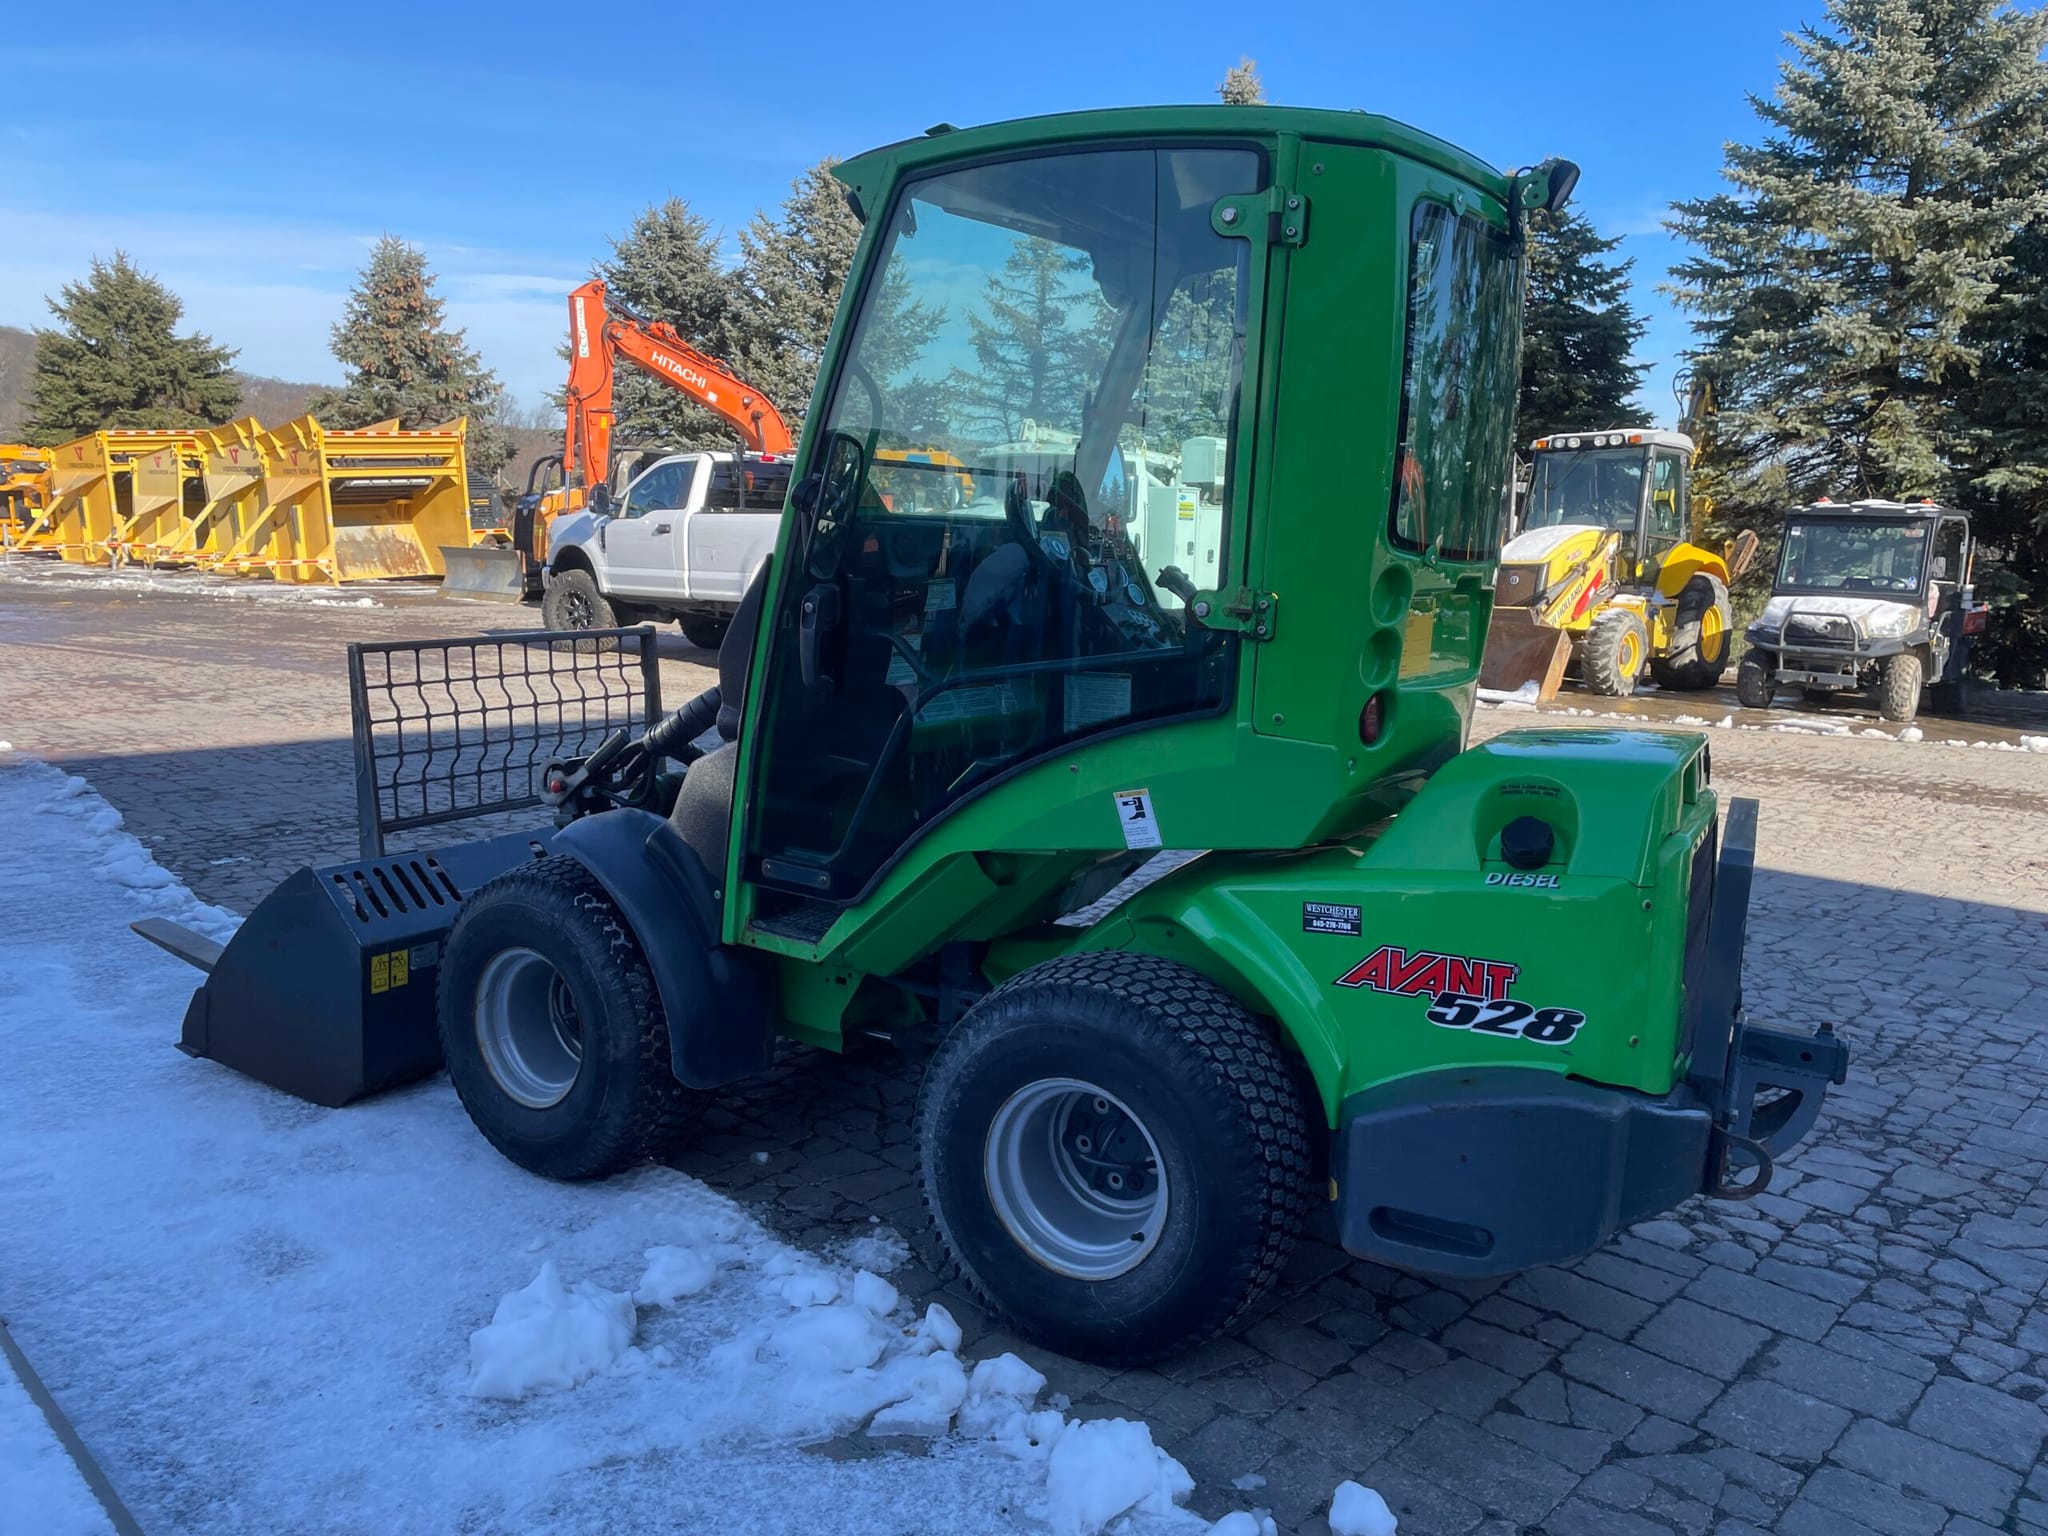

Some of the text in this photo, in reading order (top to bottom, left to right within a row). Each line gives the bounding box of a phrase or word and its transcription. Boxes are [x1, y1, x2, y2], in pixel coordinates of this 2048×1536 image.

[652, 350, 707, 389] HITACHI
[1484, 872, 1561, 889] DIESEL
[1305, 903, 1359, 918] WESTCHESTER
[1333, 945, 1518, 1002] AVANT
[1426, 991, 1587, 1046] 528
